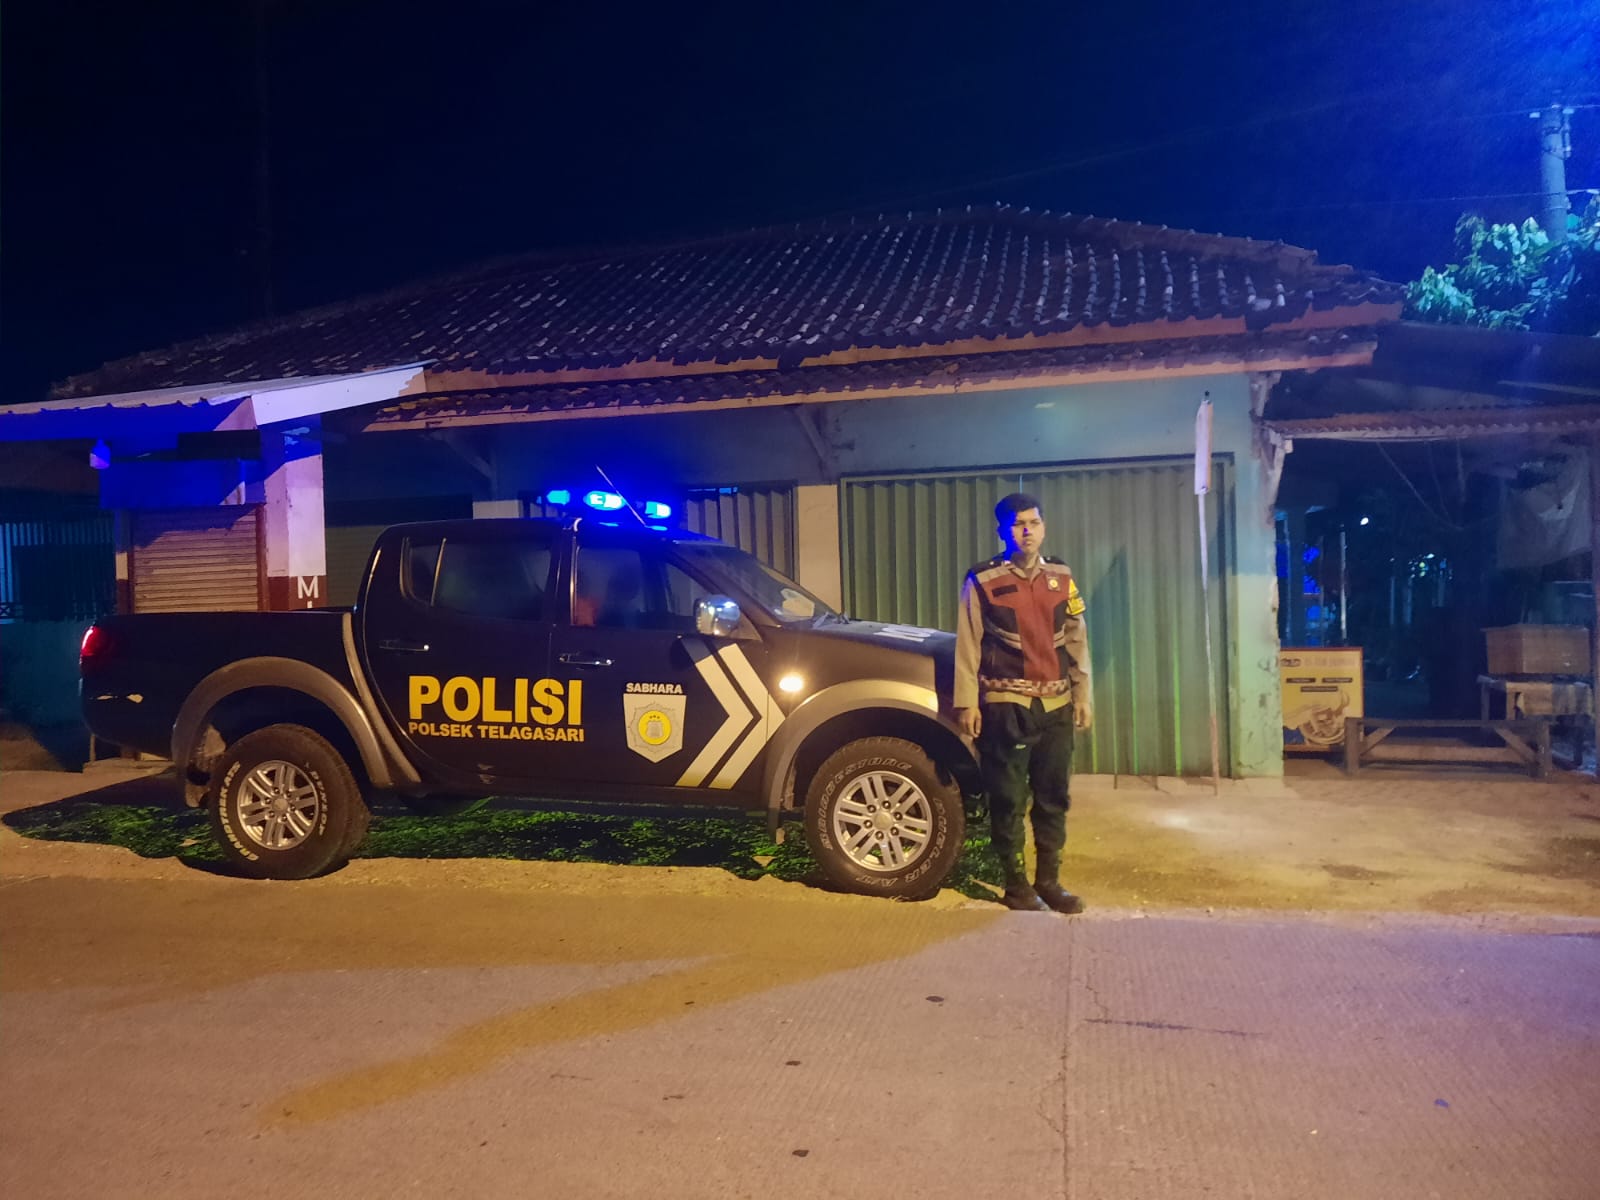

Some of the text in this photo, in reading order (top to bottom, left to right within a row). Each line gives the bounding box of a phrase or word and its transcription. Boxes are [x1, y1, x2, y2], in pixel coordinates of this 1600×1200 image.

[297, 575, 319, 599] M
[626, 682, 684, 695] SABHARA
[408, 675, 583, 726] POLISI
[408, 722, 585, 743] POLSEK TELAGASARI
